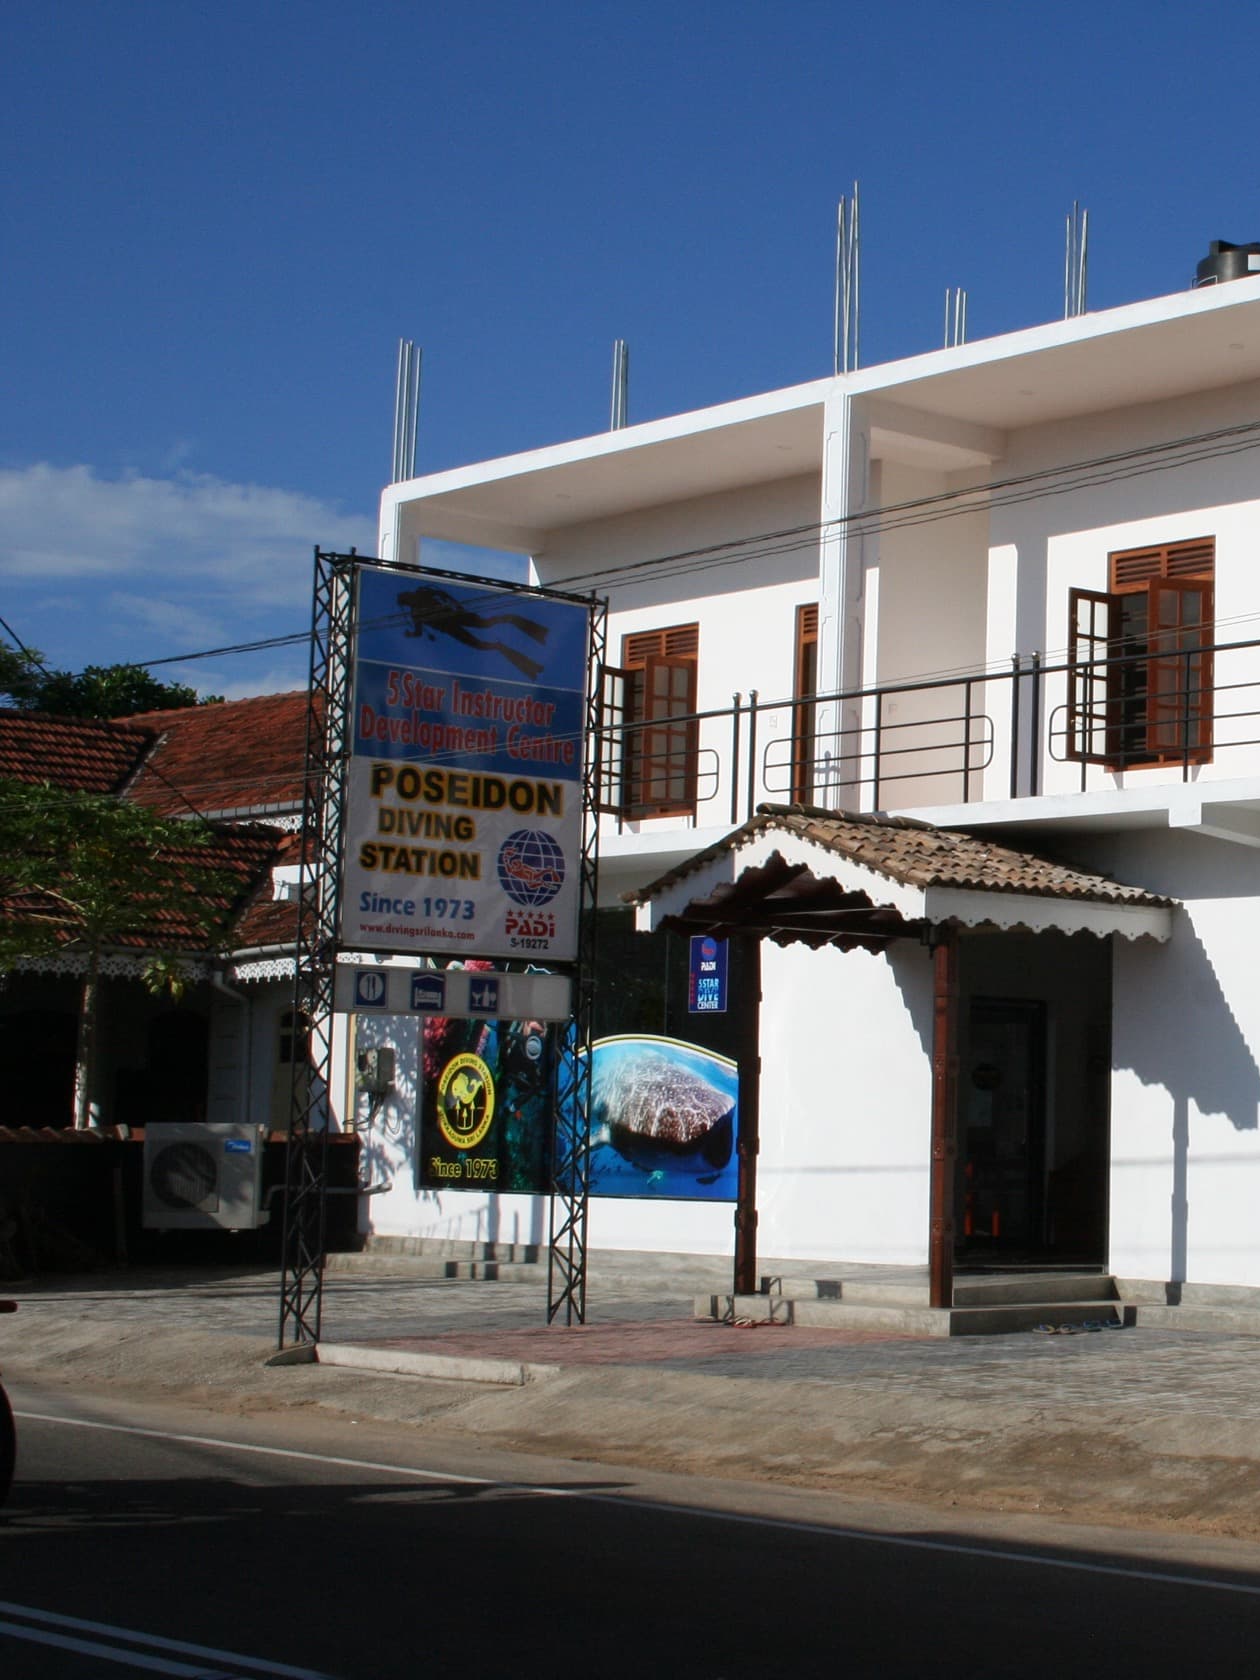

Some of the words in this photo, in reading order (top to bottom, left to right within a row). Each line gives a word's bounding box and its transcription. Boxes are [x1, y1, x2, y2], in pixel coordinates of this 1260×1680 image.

[452, 679, 556, 727] Instructor
[360, 703, 497, 758] Development
[507, 724, 575, 764] Centre
[370, 763, 564, 818] POSEIDON
[377, 806, 475, 842] DIVING
[359, 842, 481, 880] STATION
[359, 891, 416, 916] Since
[423, 897, 476, 920] 1973
[510, 937, 549, 950] S-19272
